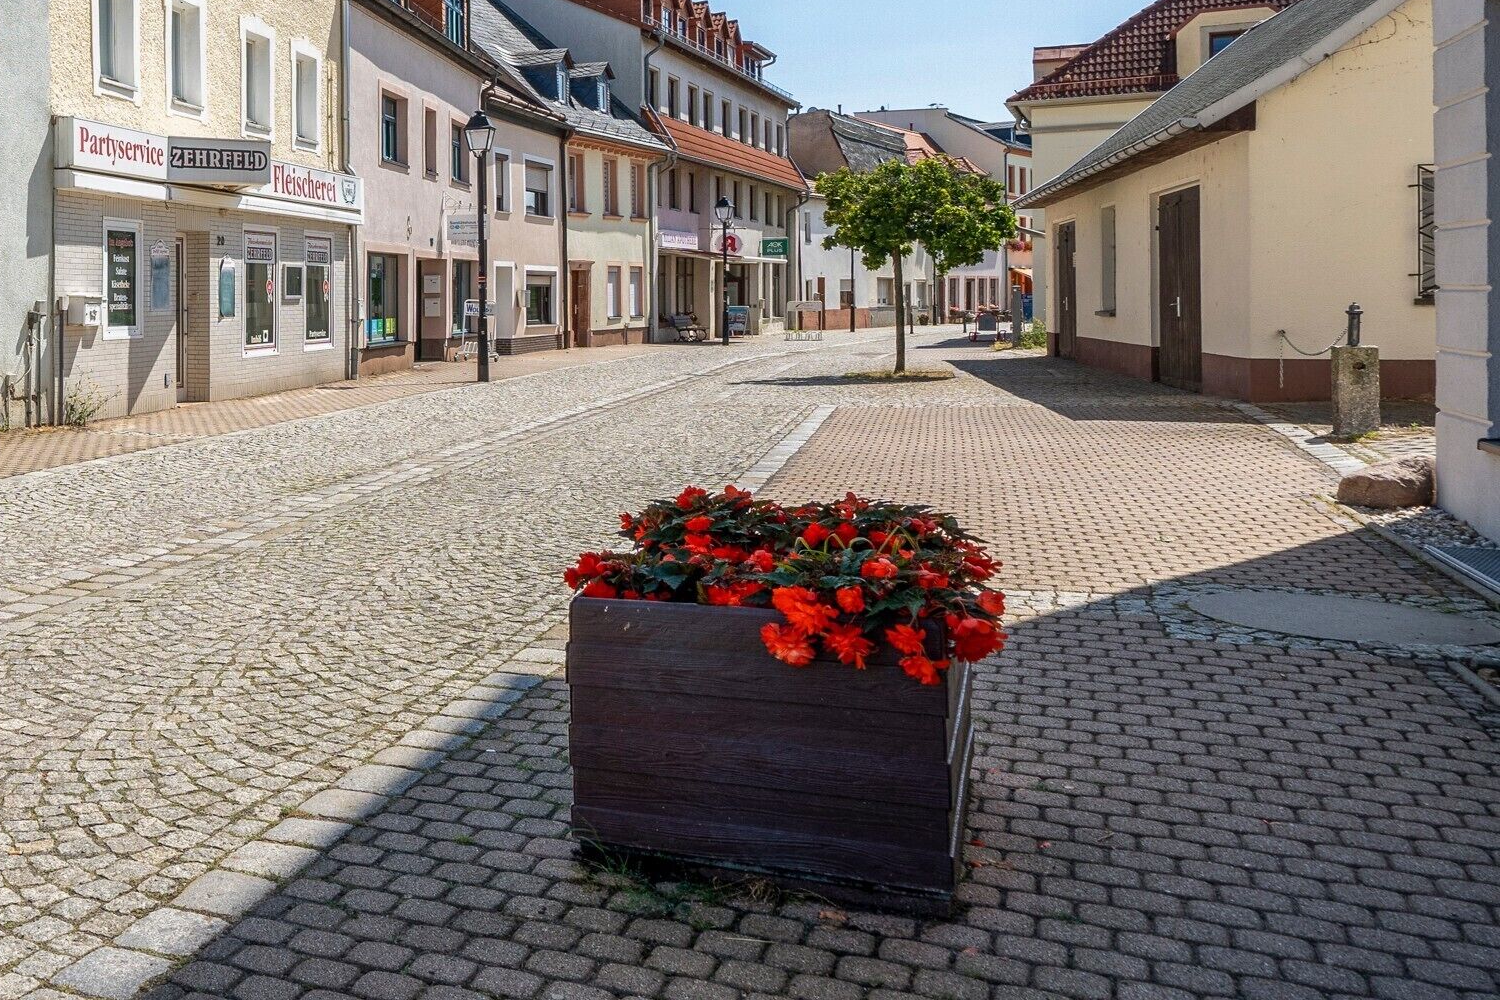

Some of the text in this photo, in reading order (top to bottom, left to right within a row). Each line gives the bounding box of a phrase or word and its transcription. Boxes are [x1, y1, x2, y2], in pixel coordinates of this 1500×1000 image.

[79, 126, 164, 166] Partyservice
[171, 148, 267, 170] ZEHRFELD
[273, 164, 337, 203] Fleischerei
